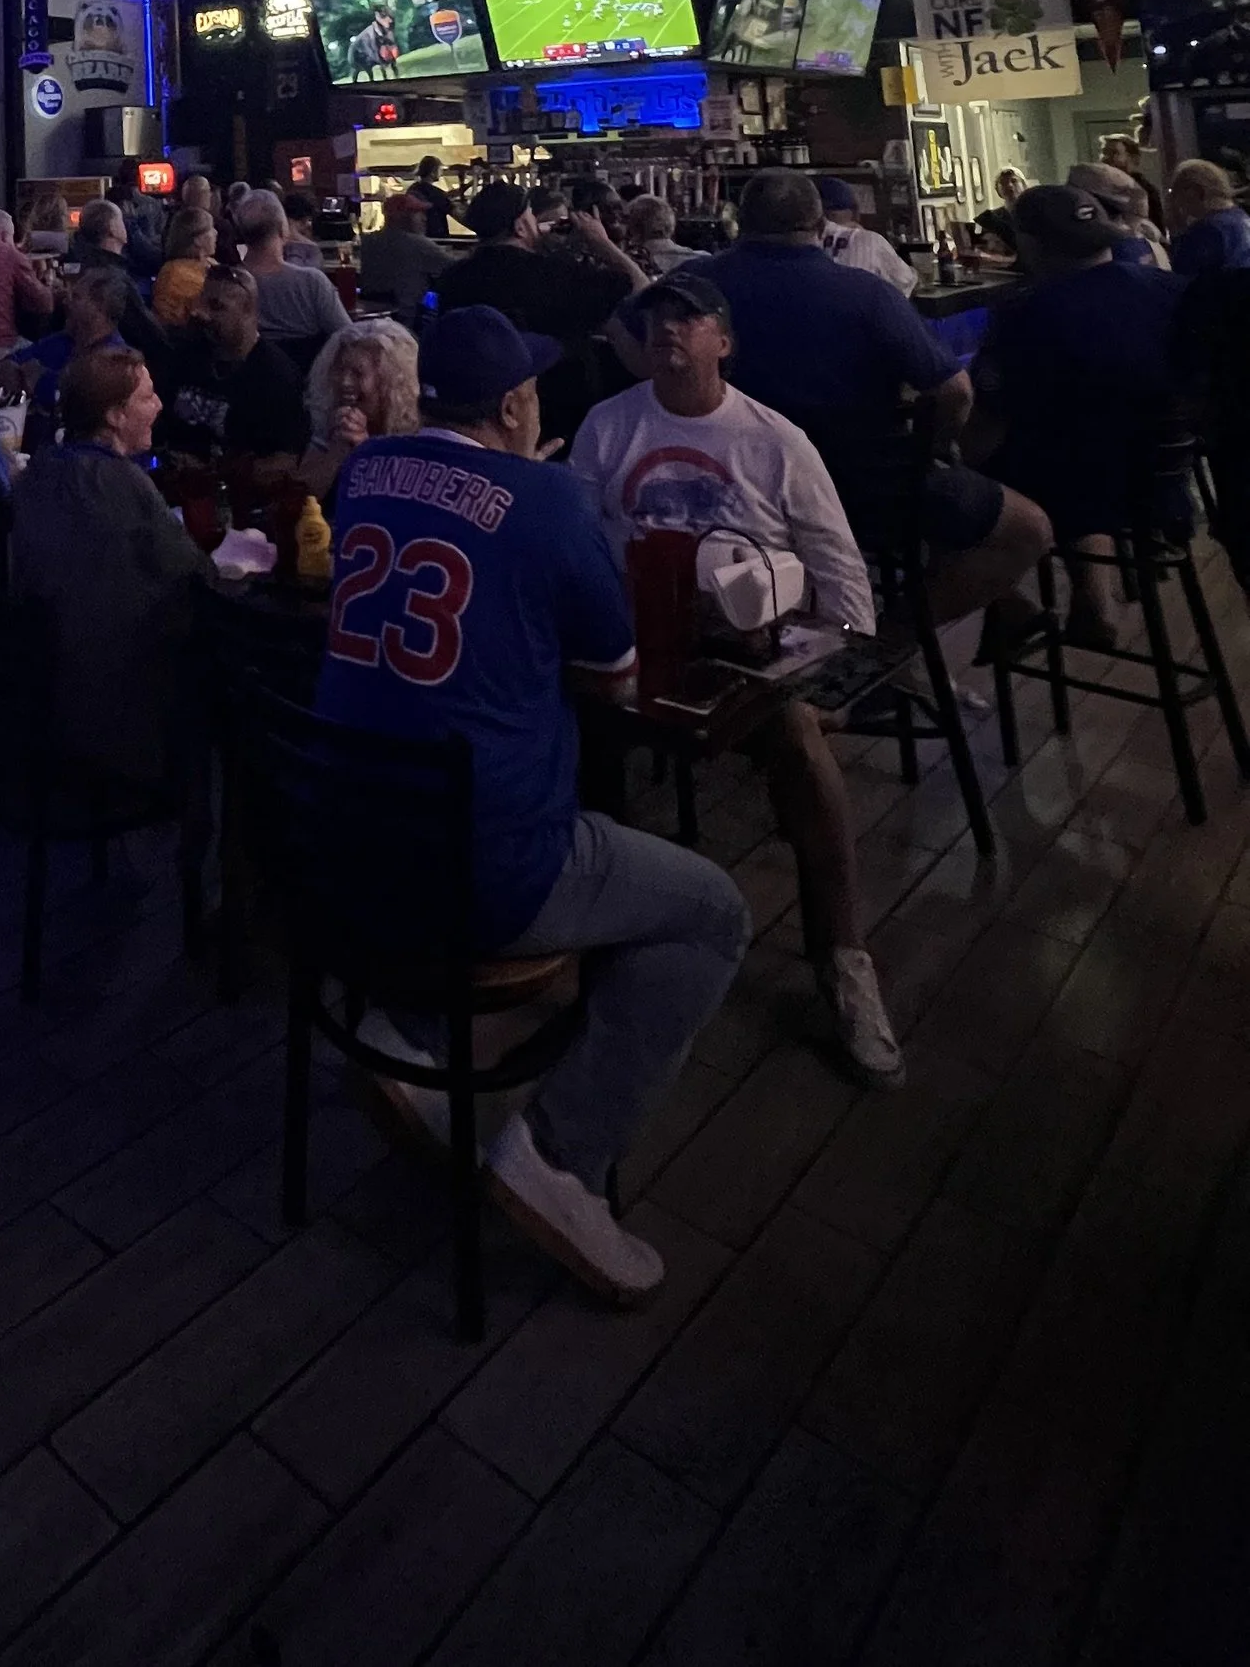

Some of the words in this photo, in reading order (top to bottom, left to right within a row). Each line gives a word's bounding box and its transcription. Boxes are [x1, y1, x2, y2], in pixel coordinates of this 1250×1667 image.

[933, 8, 983, 40] NF
[938, 42, 956, 79] WITH
[952, 34, 1065, 87] Jack
[348, 455, 515, 534] SANDBERG
[328, 522, 474, 687] 23
